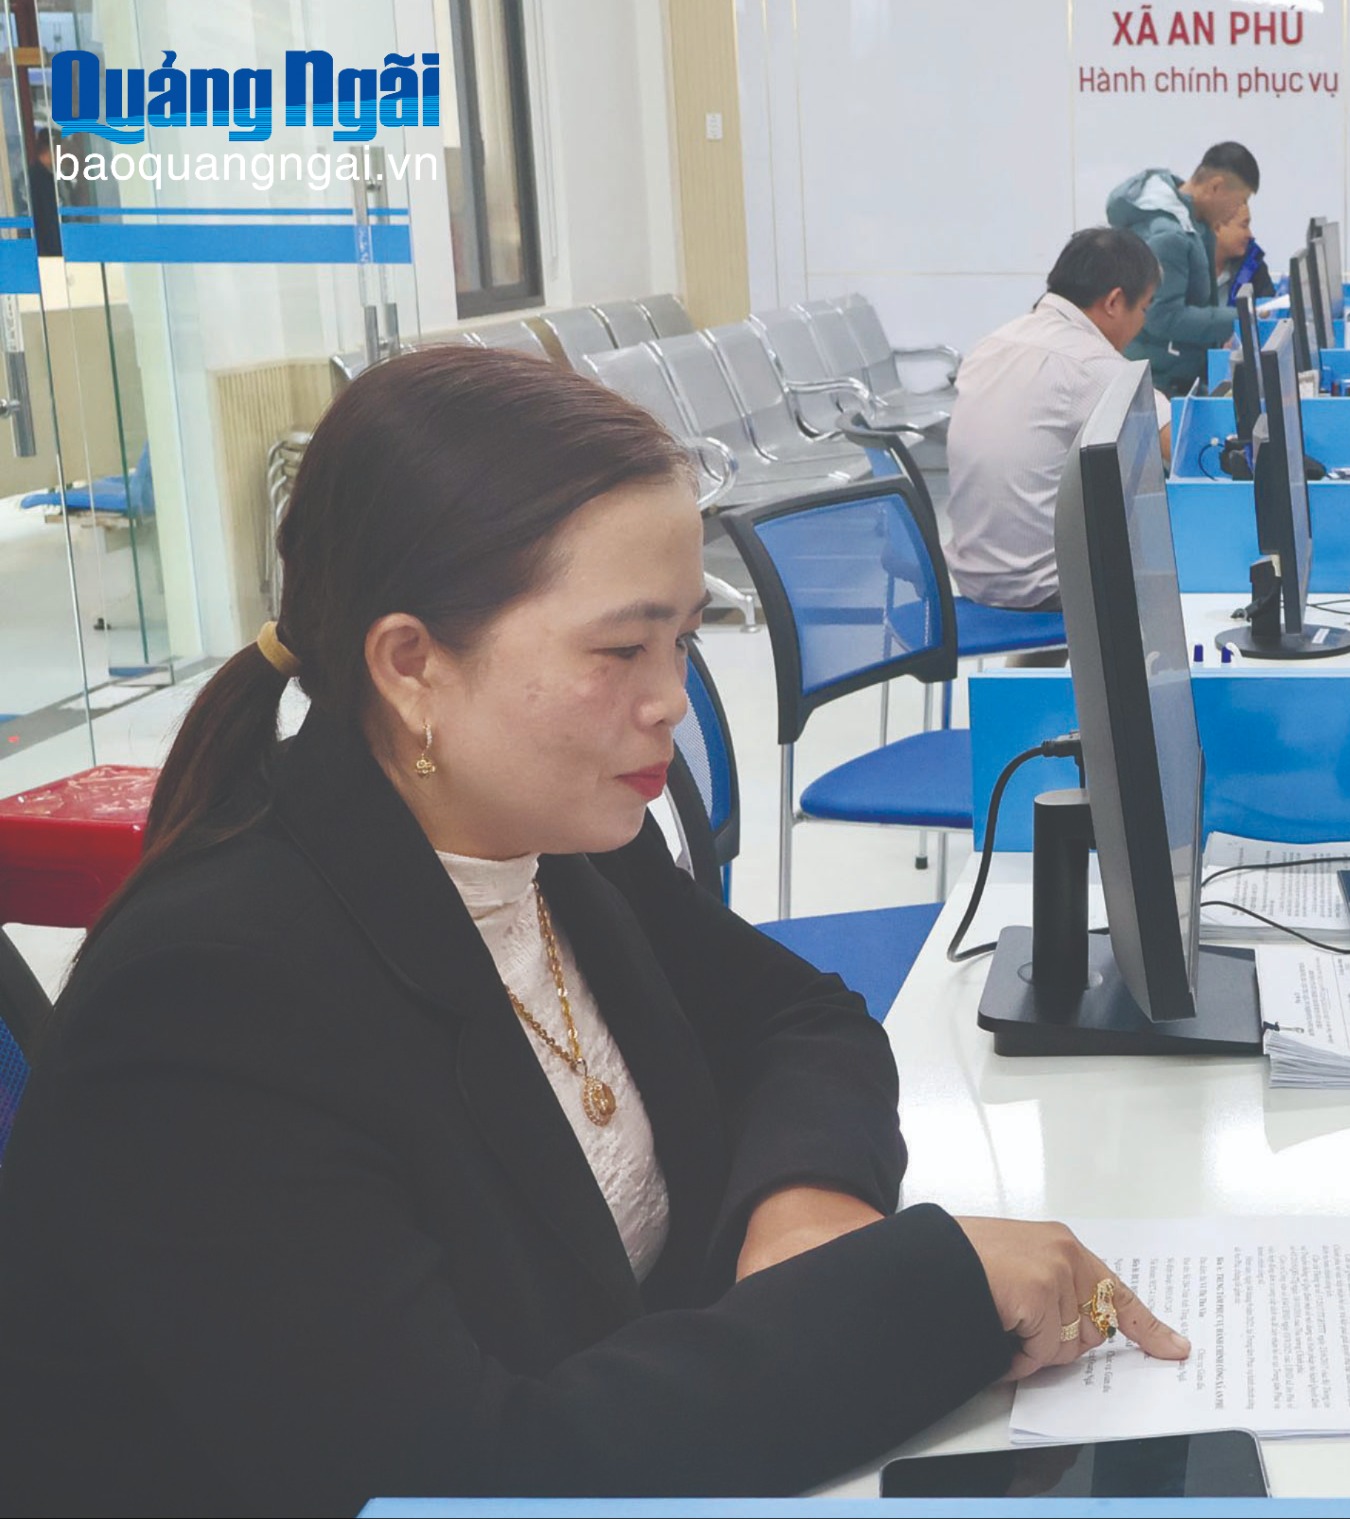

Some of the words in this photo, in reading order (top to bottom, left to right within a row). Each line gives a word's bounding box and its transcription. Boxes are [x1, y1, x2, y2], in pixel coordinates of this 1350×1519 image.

[1112, 5, 1159, 46] XÃ
[1167, 11, 1214, 46] AN
[1230, 4, 1303, 46] PHÚ
[1079, 66, 1146, 93] Hành
[1154, 66, 1228, 93] chính
[1237, 66, 1303, 98] phục
[1308, 71, 1339, 98] vụ
